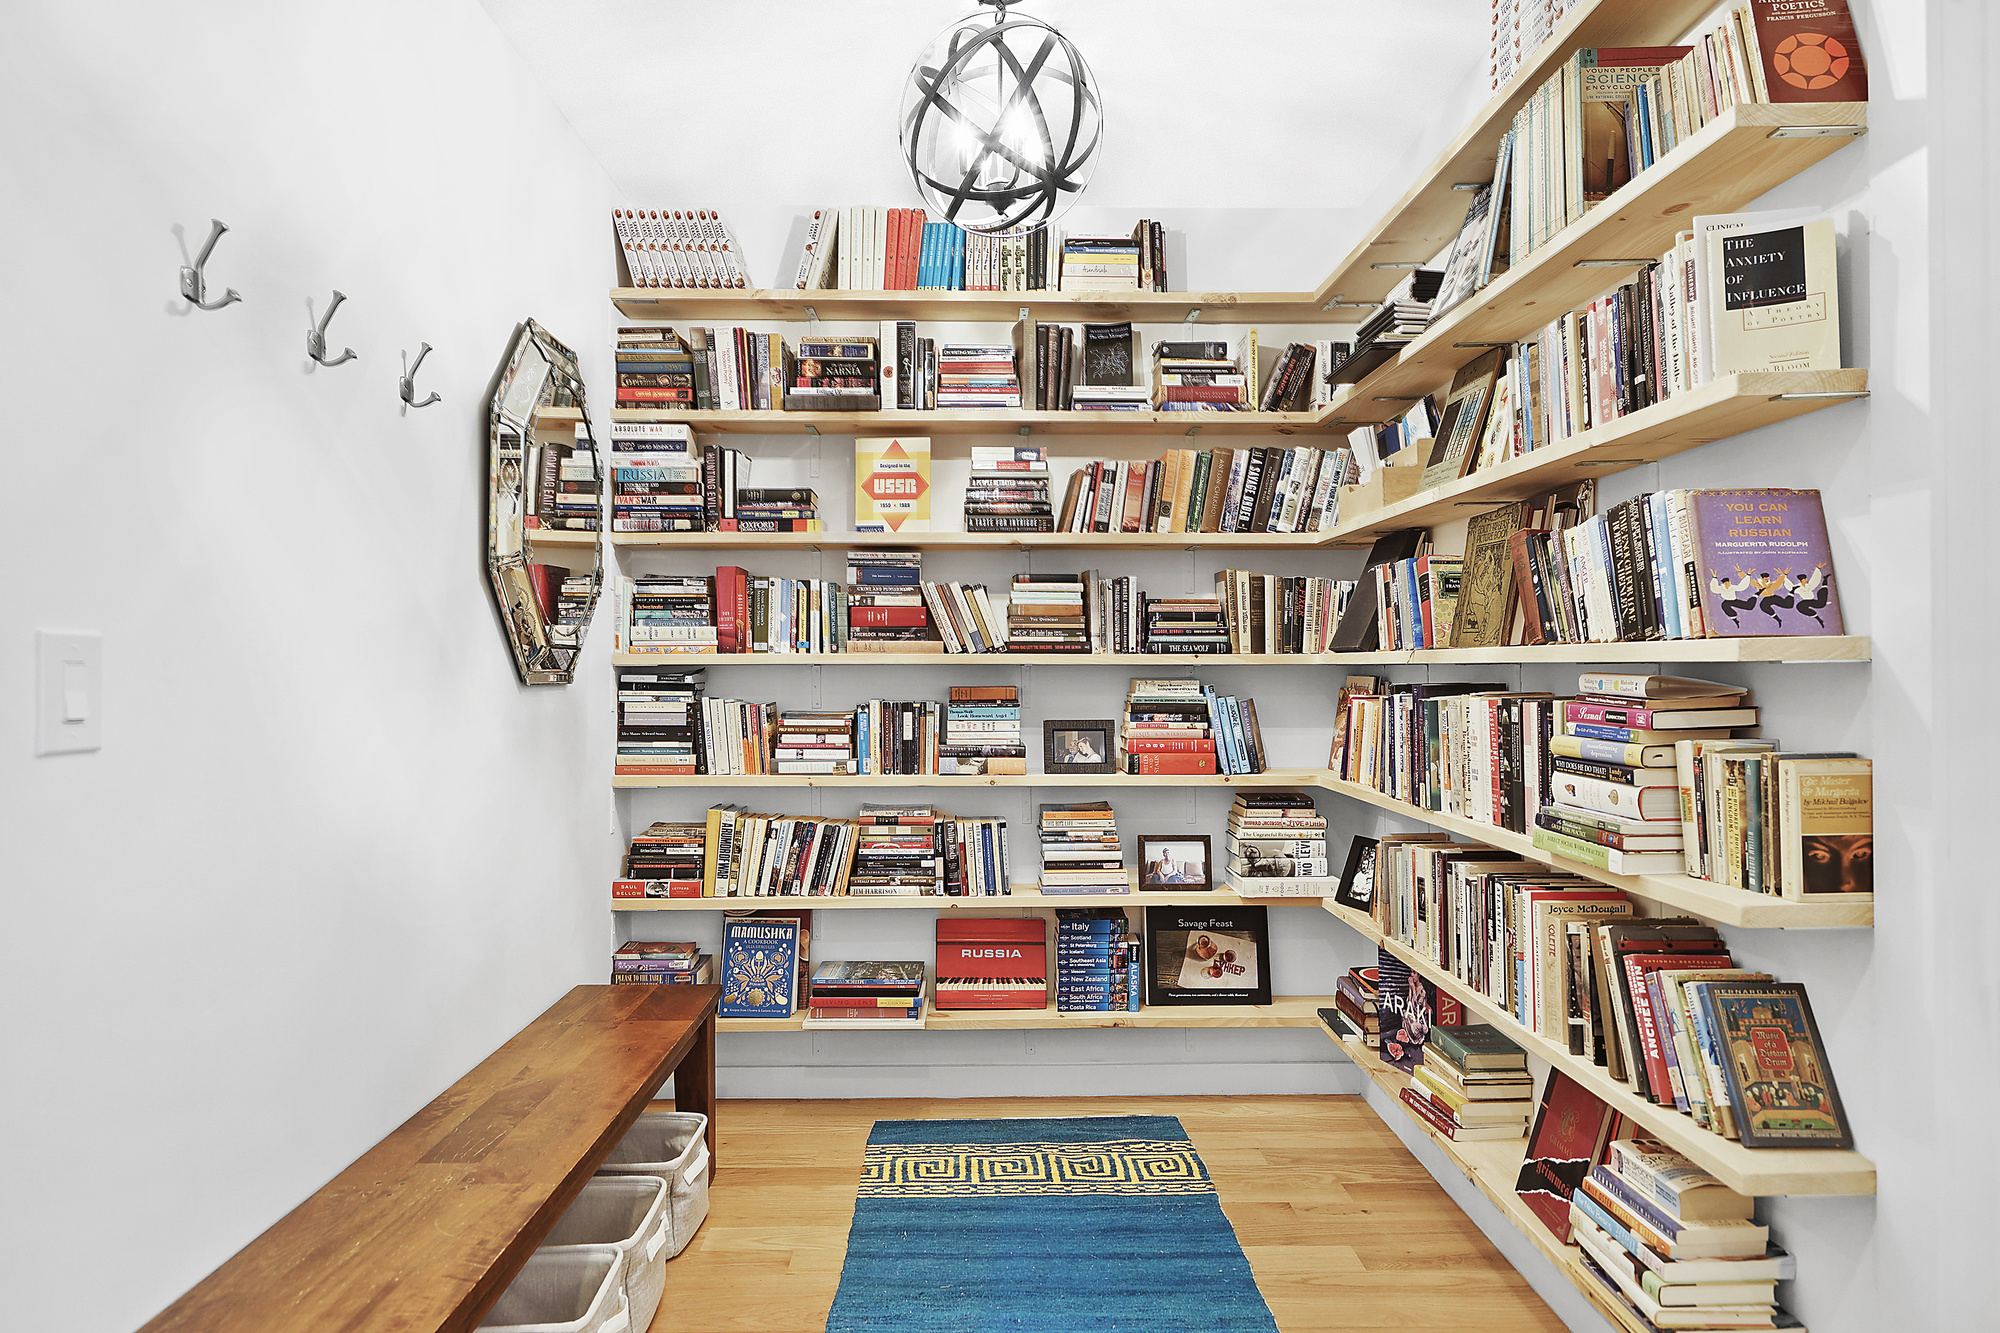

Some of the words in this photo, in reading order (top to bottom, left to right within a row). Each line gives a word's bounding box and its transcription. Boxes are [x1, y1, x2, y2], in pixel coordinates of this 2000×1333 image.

[1772, 1, 1825, 11] POETICS
[1724, 239, 1754, 251] THE
[1726, 251, 1786, 268] ANXIETY
[1726, 274, 1744, 285] OF
[1727, 283, 1805, 302] INFLUENCE
[1774, 362, 1810, 372] BLOOM
[622, 469, 667, 480] RUSSIA
[705, 452, 716, 490] HUNTING
[873, 478, 917, 493] USSR
[1244, 466, 1262, 494] SAVAGE
[706, 491, 717, 509] EVIL
[1178, 480, 1190, 519] POSTWAR
[1238, 495, 1254, 522] ORDER
[1725, 503, 1754, 512] YOU
[1758, 503, 1788, 512] CAN
[968, 518, 973, 527] A
[975, 518, 993, 527] TASTE
[995, 518, 1007, 527] FOR
[1619, 507, 1628, 534] TIME
[1735, 515, 1782, 524] LEARN
[1612, 521, 1623, 558] ROBERT
[1728, 528, 1792, 537] RUSSIAN
[1623, 533, 1632, 574] ENOUGH
[1298, 589, 1306, 617] FIXER
[1628, 596, 1636, 624] LOVE
[1577, 706, 1604, 721] Sexual
[1555, 759, 1565, 768] WHY
[1565, 761, 1578, 770] DOES
[1578, 762, 1584, 771] HE
[1584, 763, 1592, 772] DO
[1592, 764, 1607, 775] THAT?
[1608, 768, 1623, 777] Lundy
[1801, 776, 1817, 787] The
[1820, 776, 1851, 787] Master
[1815, 787, 1860, 798] Margarita
[1803, 798, 1812, 806] by
[1812, 797, 1839, 806] Mikhail
[719, 829, 732, 855] RUMOR
[1302, 840, 1311, 858] LEVI
[719, 855, 730, 863] OF
[717, 863, 729, 880] WAR
[853, 888, 864, 896] JIM
[1548, 904, 1575, 916] Joyce
[1577, 904, 1626, 916] McDougall
[1071, 922, 1090, 932] Italy
[1178, 918, 1206, 929] Savage
[1209, 918, 1234, 928] Feast
[730, 925, 793, 940] MAMUSHKA
[961, 949, 1022, 958] RUSSIA
[615, 974, 634, 984] PLEASE
[634, 974, 640, 983] TO
[1130, 963, 1138, 997] ALASKA
[1634, 965, 1647, 994] MIN
[1382, 991, 1433, 1028] ARAKI
[1643, 998, 1660, 1060] ANCHEE
[1754, 1031, 1781, 1040] Music
[1763, 1040, 1770, 1049] of
[1759, 1048, 1788, 1058] Distant
[1765, 1059, 1788, 1068] Drum
[1549, 1135, 1574, 1158] GRIMM'S
[1535, 1160, 1574, 1201] grimmest
[1584, 1180, 1598, 1194] EMILY
[1598, 1191, 1612, 1206] OSTER
[1613, 1201, 1639, 1227] EXPECTING
[1639, 1221, 1659, 1245] BETTER
